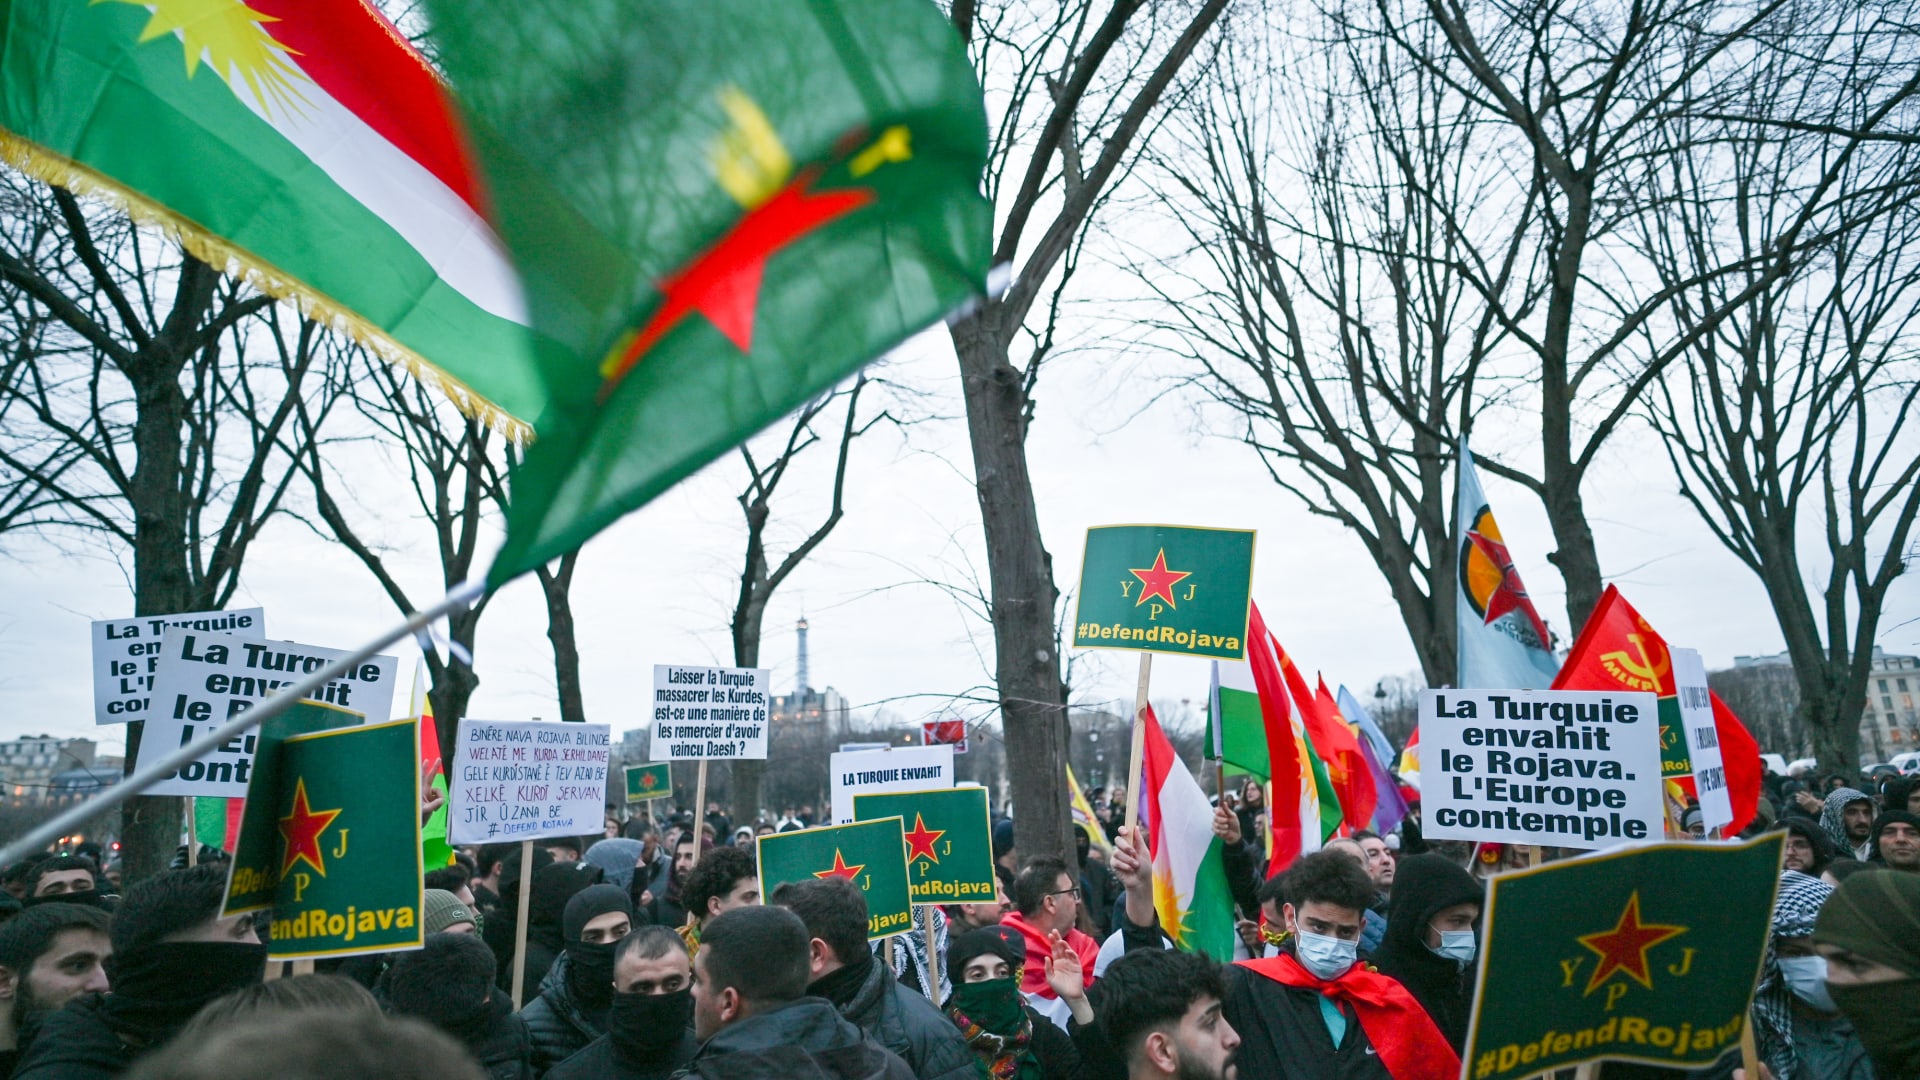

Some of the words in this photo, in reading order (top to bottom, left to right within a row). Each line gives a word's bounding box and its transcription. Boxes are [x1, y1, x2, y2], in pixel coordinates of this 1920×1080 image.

[1120, 581, 1135, 597] Y
[1149, 603, 1163, 621] P
[1183, 584, 1197, 600] J
[106, 624, 139, 640] La
[1078, 623, 1239, 650] #DefendRojava
[181, 635, 229, 665] La
[111, 660, 137, 676] le
[668, 668, 704, 685] Laisser
[708, 669, 716, 685] la
[719, 670, 754, 689] Turquie
[173, 694, 212, 721] le
[656, 689, 709, 703] massacrer
[712, 688, 725, 703] les
[728, 688, 765, 707] Kurdes,
[655, 705, 685, 720] est-ce
[688, 708, 708, 720] une
[710, 705, 750, 721] manière
[753, 706, 765, 721] de
[1436, 695, 1477, 718] La
[1488, 696, 1639, 727] Turquie
[505, 730, 532, 743] NAVA
[537, 731, 571, 744] ROJAVA
[658, 723, 672, 738] les
[675, 723, 723, 738] remercier
[725, 723, 761, 738] d'avoir
[1462, 725, 1611, 751] envahit
[513, 747, 526, 760] ME
[671, 741, 704, 757] vaincu
[707, 741, 735, 756] Daesh
[739, 740, 745, 756] ?
[843, 773, 855, 786] LA
[857, 769, 899, 784] TURQUIE
[901, 766, 942, 781] ENVAHIT
[1441, 749, 1474, 773] le
[1487, 750, 1636, 781] Rojava.
[1452, 776, 1627, 812] L'Europe
[504, 821, 537, 834] DEFEND
[1436, 807, 1648, 841] contemple
[294, 873, 311, 903] P
[333, 829, 349, 858] J
[918, 861, 930, 877] P
[943, 840, 952, 856] J
[862, 874, 871, 891] J
[1560, 956, 1583, 988] Y
[1604, 982, 1628, 1011] P
[1668, 948, 1695, 977] J
